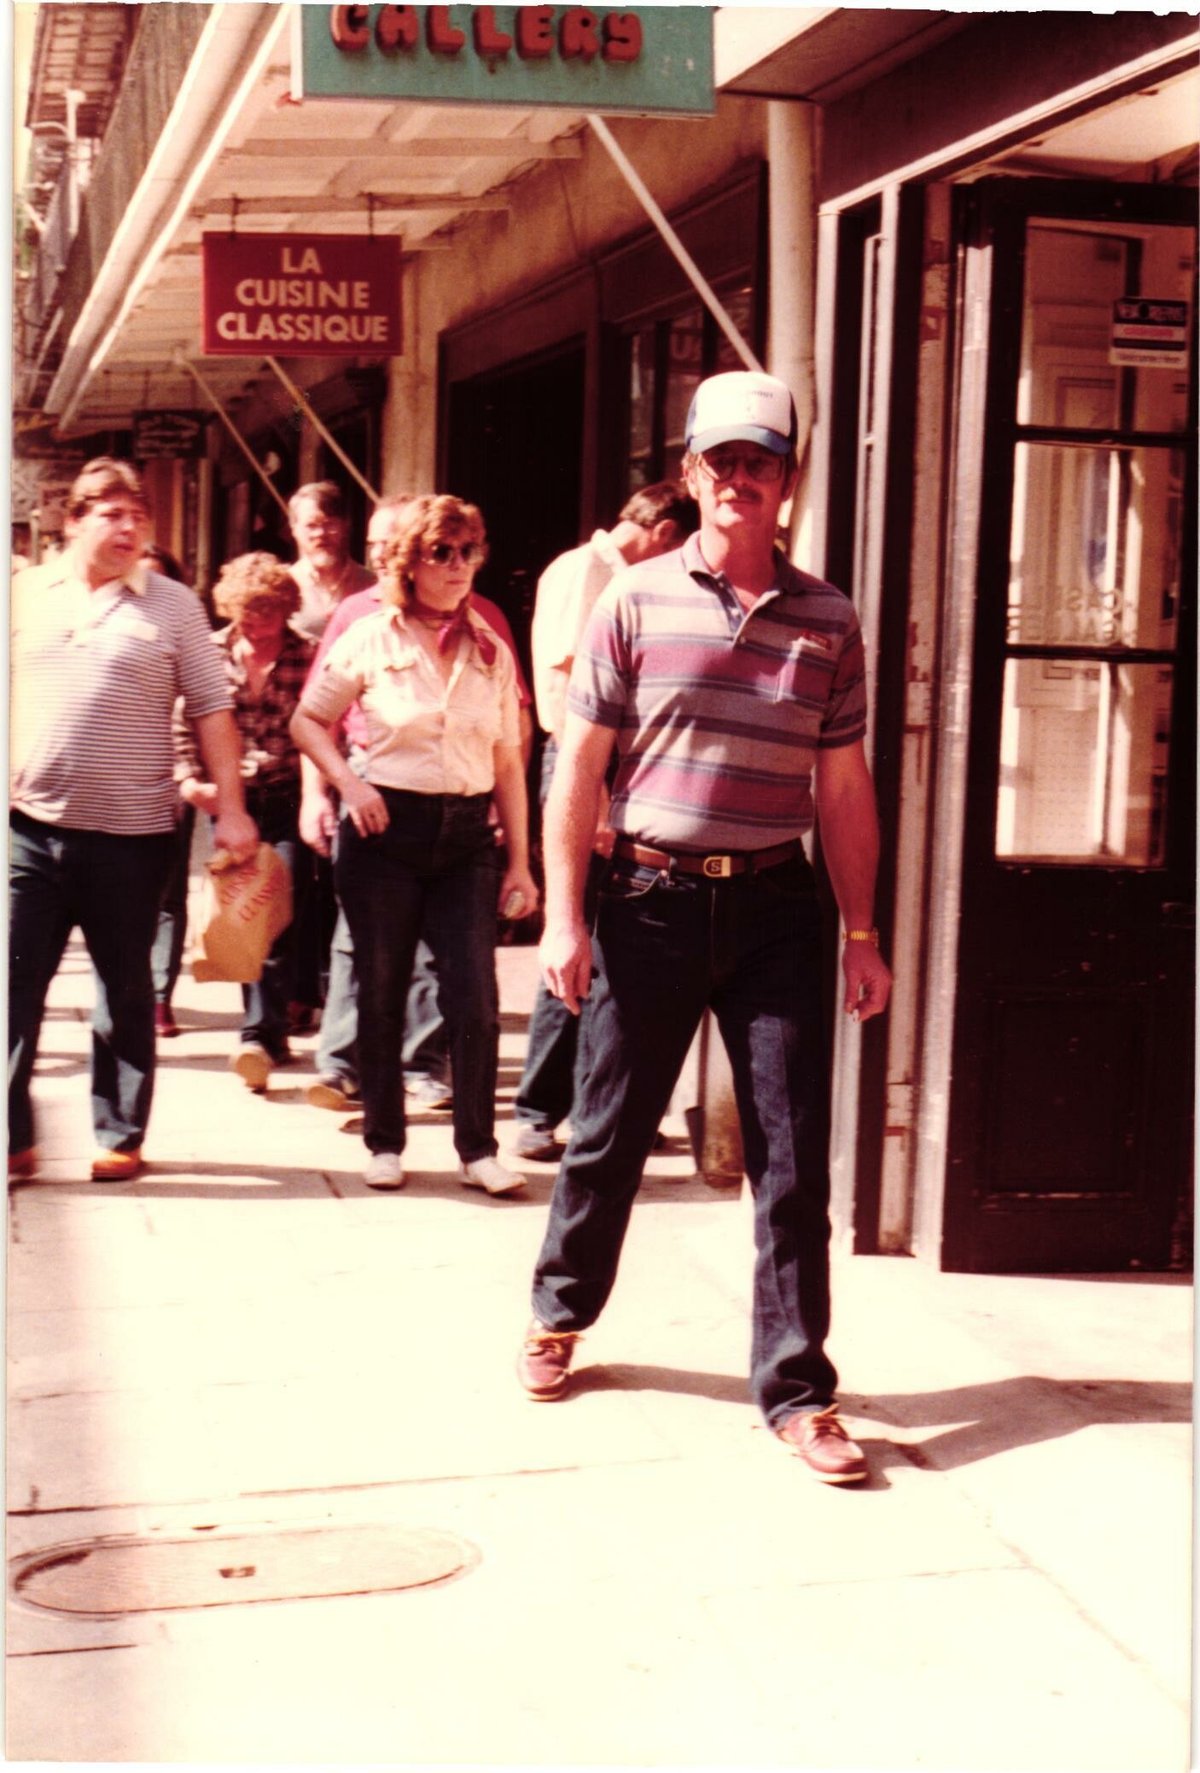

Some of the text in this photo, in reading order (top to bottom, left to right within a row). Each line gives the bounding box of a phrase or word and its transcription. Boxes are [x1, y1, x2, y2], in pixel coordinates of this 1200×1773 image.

[282, 247, 322, 274] LA
[235, 278, 370, 308] CUISINE
[216, 311, 388, 342] CLASSIQUE
